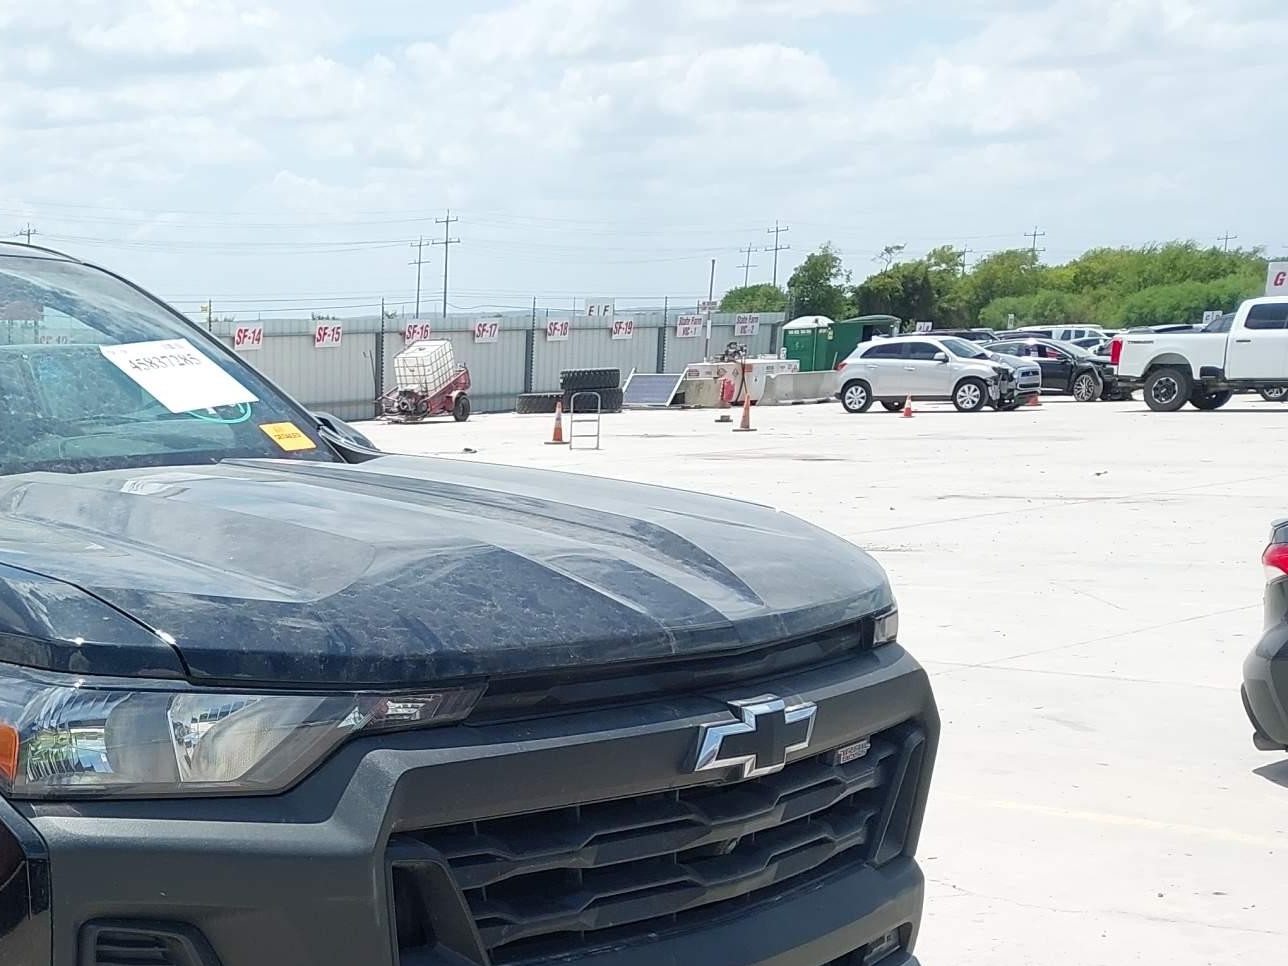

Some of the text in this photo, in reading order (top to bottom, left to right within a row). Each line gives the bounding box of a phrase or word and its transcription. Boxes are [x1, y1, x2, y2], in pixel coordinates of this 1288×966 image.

[1273, 271, 1287, 287] G
[315, 326, 342, 343] SF-15
[406, 323, 430, 340] SF-16
[475, 322, 498, 338] SF-17
[547, 321, 569, 336] SF-18
[613, 320, 633, 335] SF-19
[235, 328, 263, 346] SF-14
